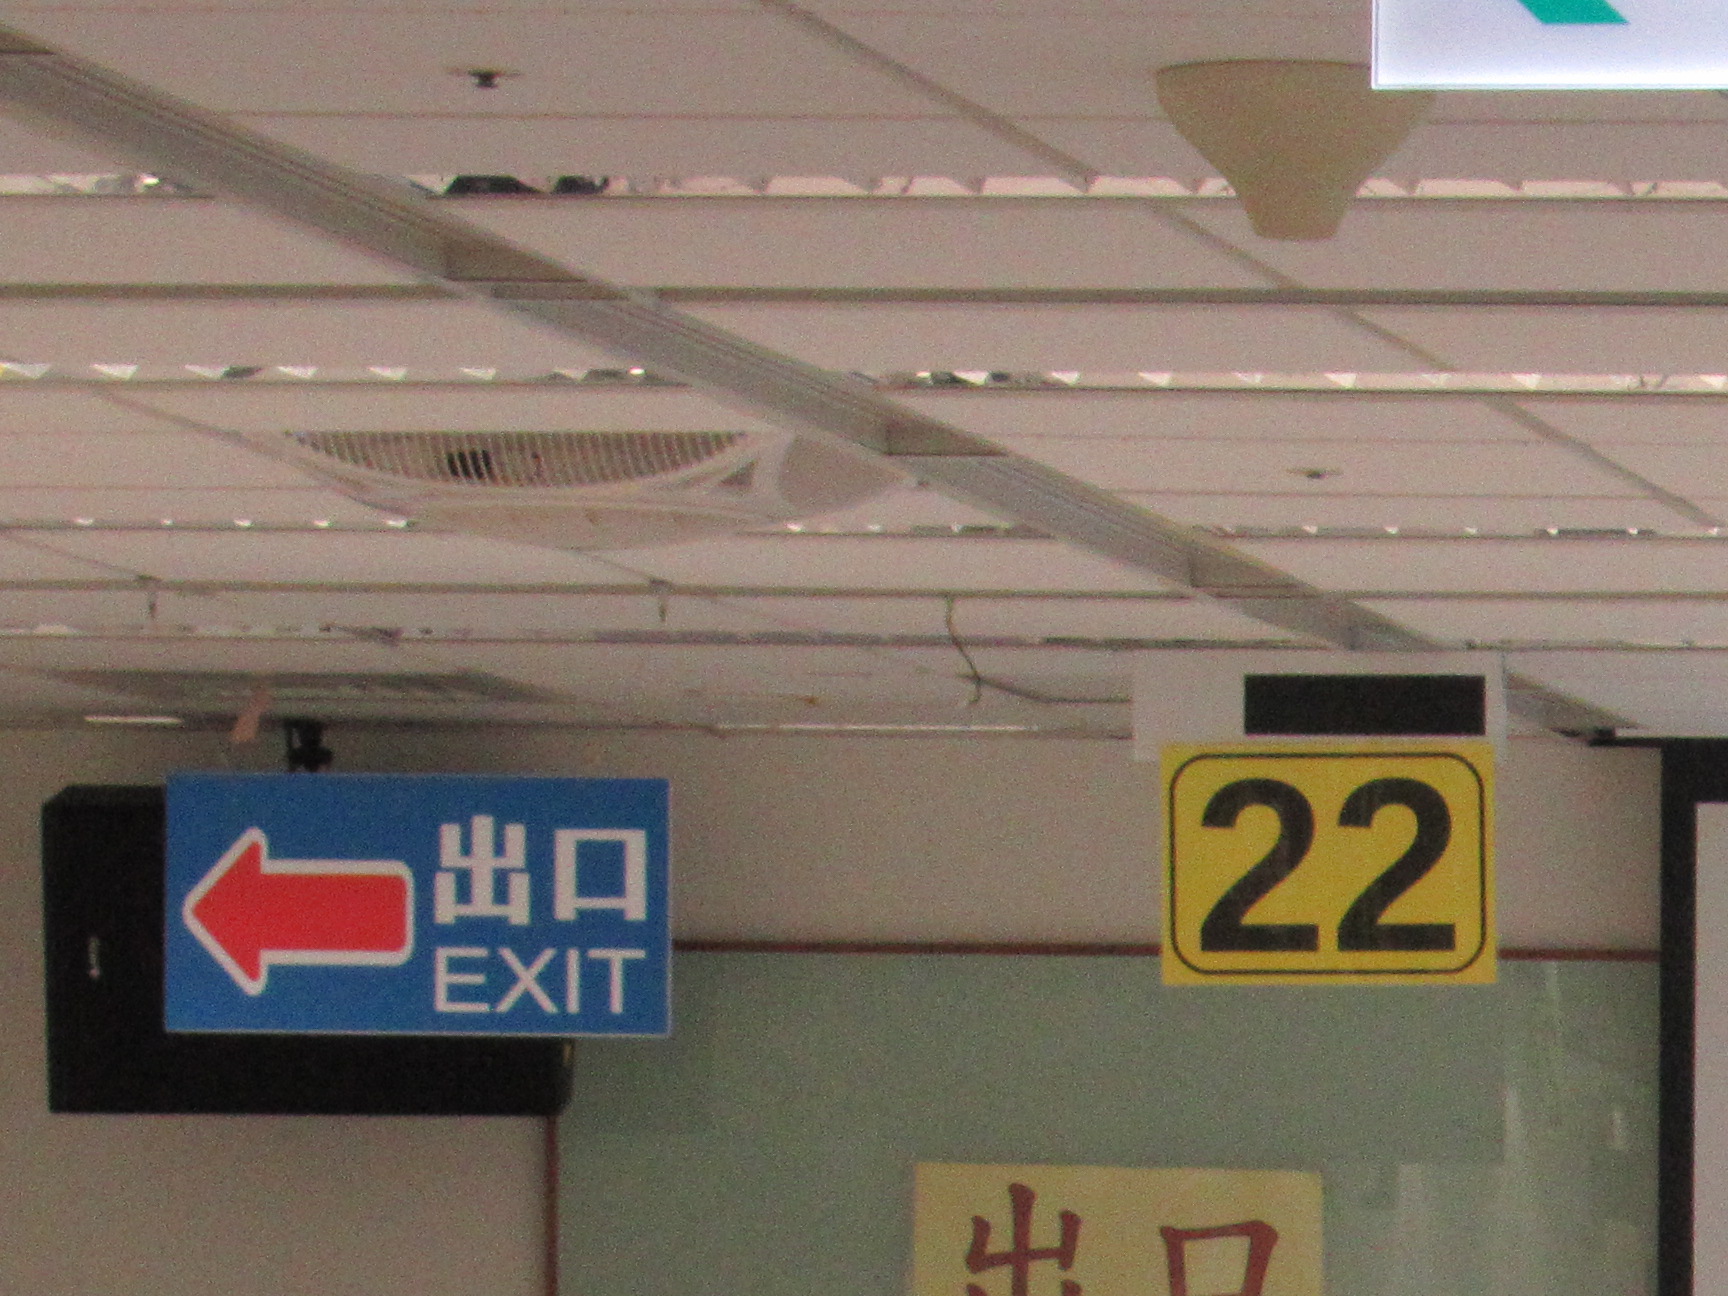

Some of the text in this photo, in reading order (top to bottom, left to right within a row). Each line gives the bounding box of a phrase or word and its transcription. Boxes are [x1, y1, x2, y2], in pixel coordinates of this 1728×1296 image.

[433, 814, 648, 926] 出口
[1199, 777, 1458, 954] 22
[433, 945, 648, 1015] EXIT
